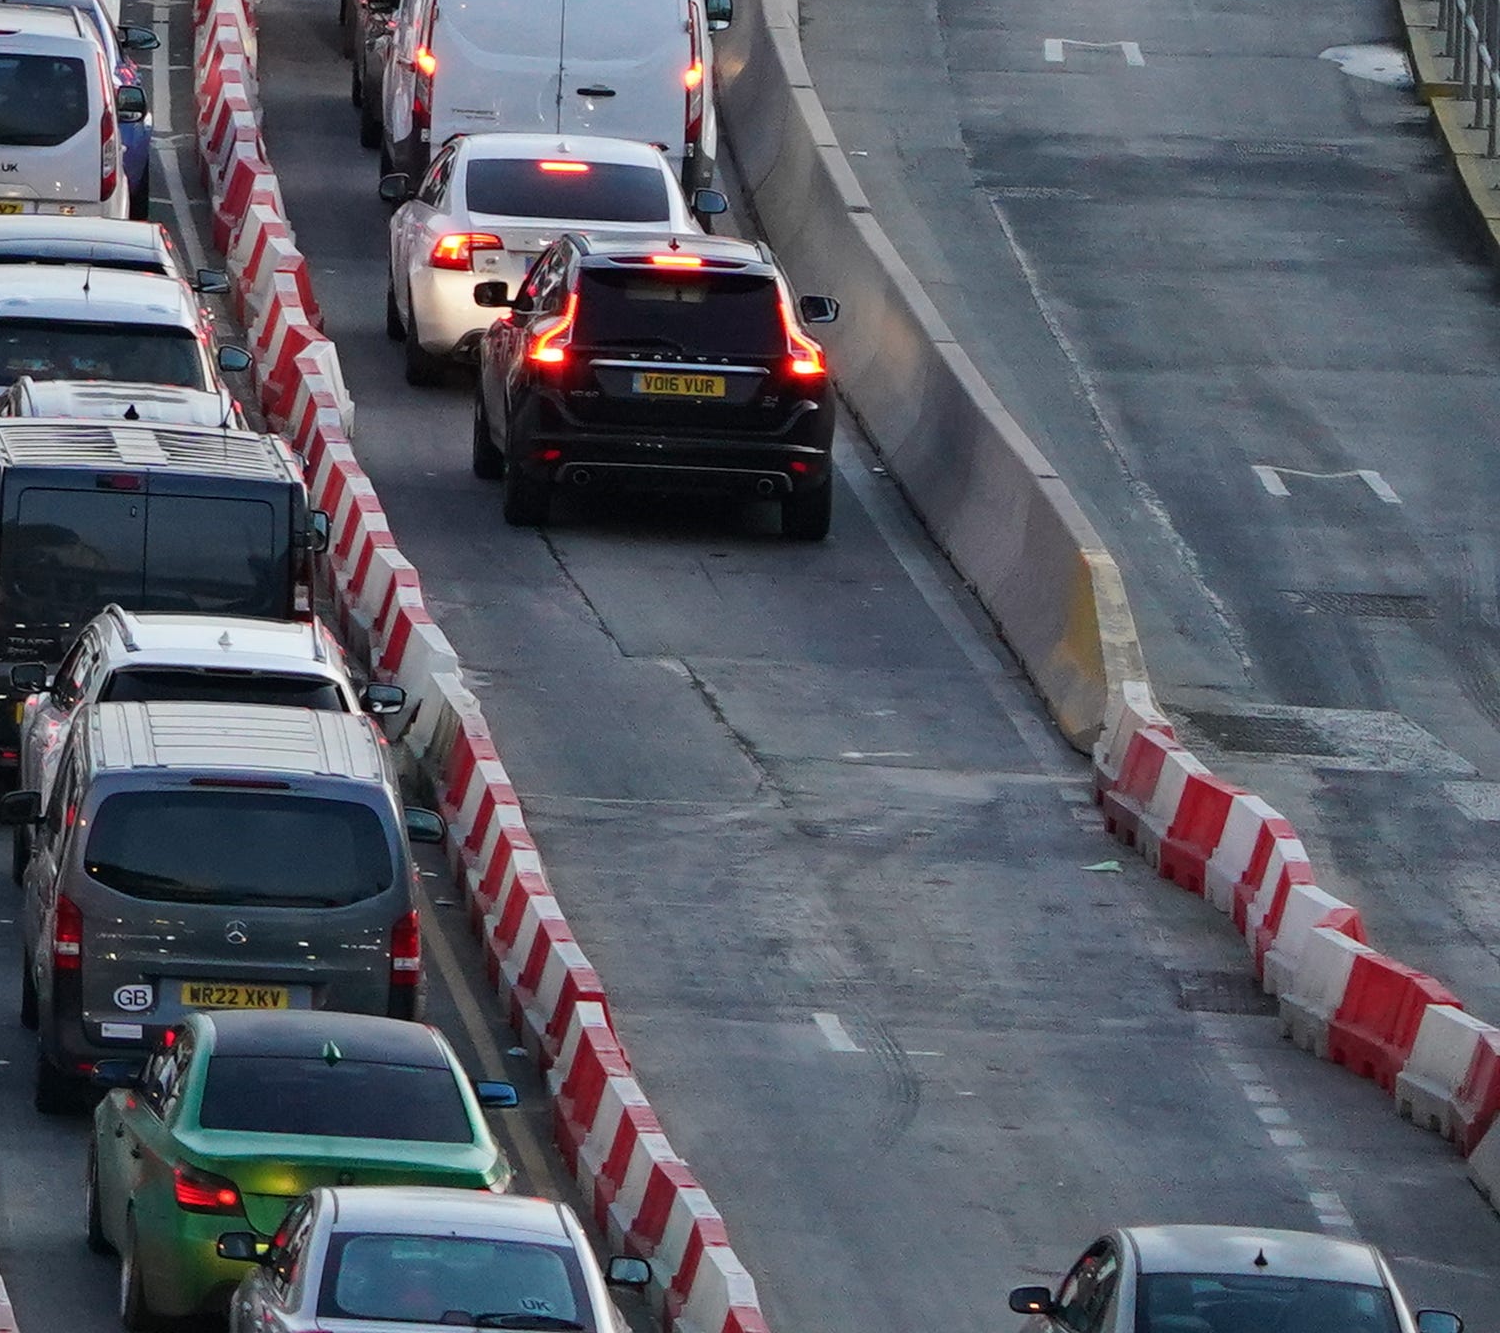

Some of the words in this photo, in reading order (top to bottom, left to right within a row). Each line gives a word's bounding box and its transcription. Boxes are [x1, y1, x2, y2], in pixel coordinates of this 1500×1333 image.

[1, 164, 17, 172] UK
[645, 376, 679, 391] VO16
[684, 377, 714, 392] VUR
[118, 989, 147, 1005] GB
[190, 984, 239, 1003] WR22
[245, 987, 280, 1007] XKV
[523, 1300, 550, 1312] UK
